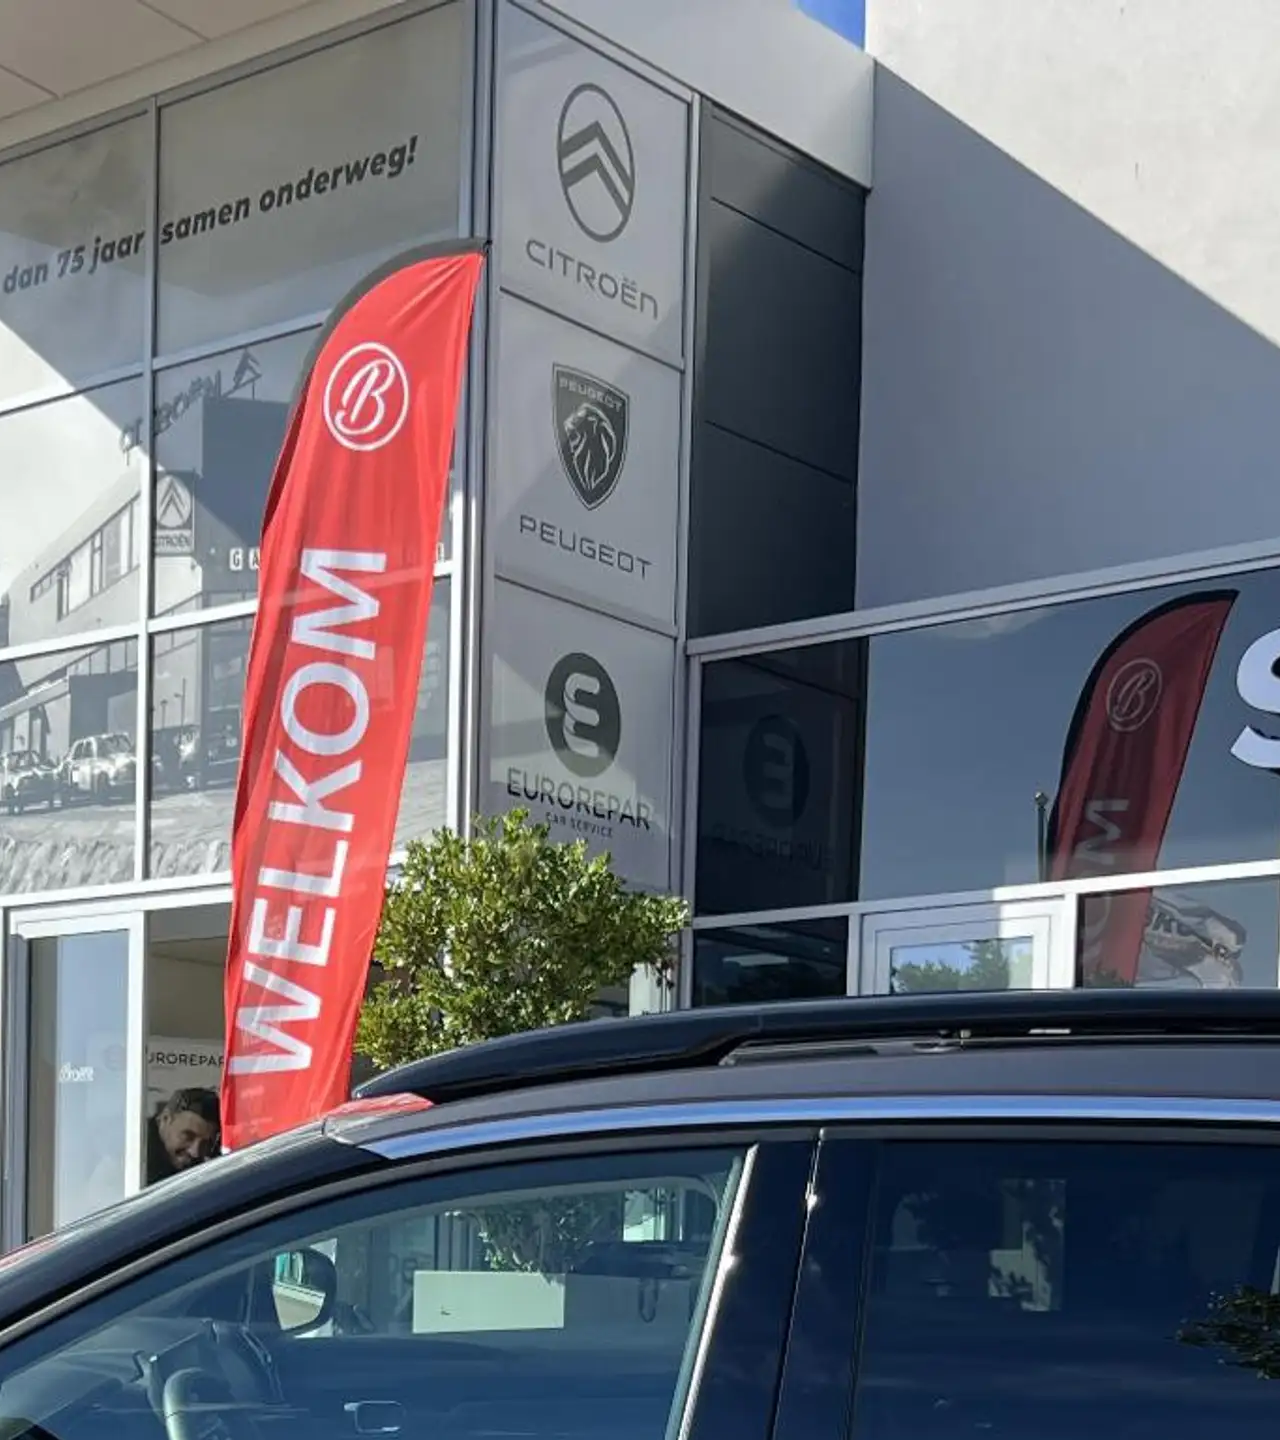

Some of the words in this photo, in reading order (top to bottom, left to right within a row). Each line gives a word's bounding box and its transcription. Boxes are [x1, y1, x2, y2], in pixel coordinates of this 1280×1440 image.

[3, 260, 49, 295] dan
[57, 245, 86, 279] 75
[88, 229, 146, 275] jaar
[160, 196, 251, 246] samen
[259, 134, 419, 213] onderweg!
[558, 375, 623, 413] PEUGEOT
[519, 513, 653, 581] PEUGEOT
[227, 546, 387, 1078] WELKOM
[506, 765, 651, 831] EUROREPAR
[546, 810, 567, 826] CAR
[571, 814, 614, 839] SERVICE
